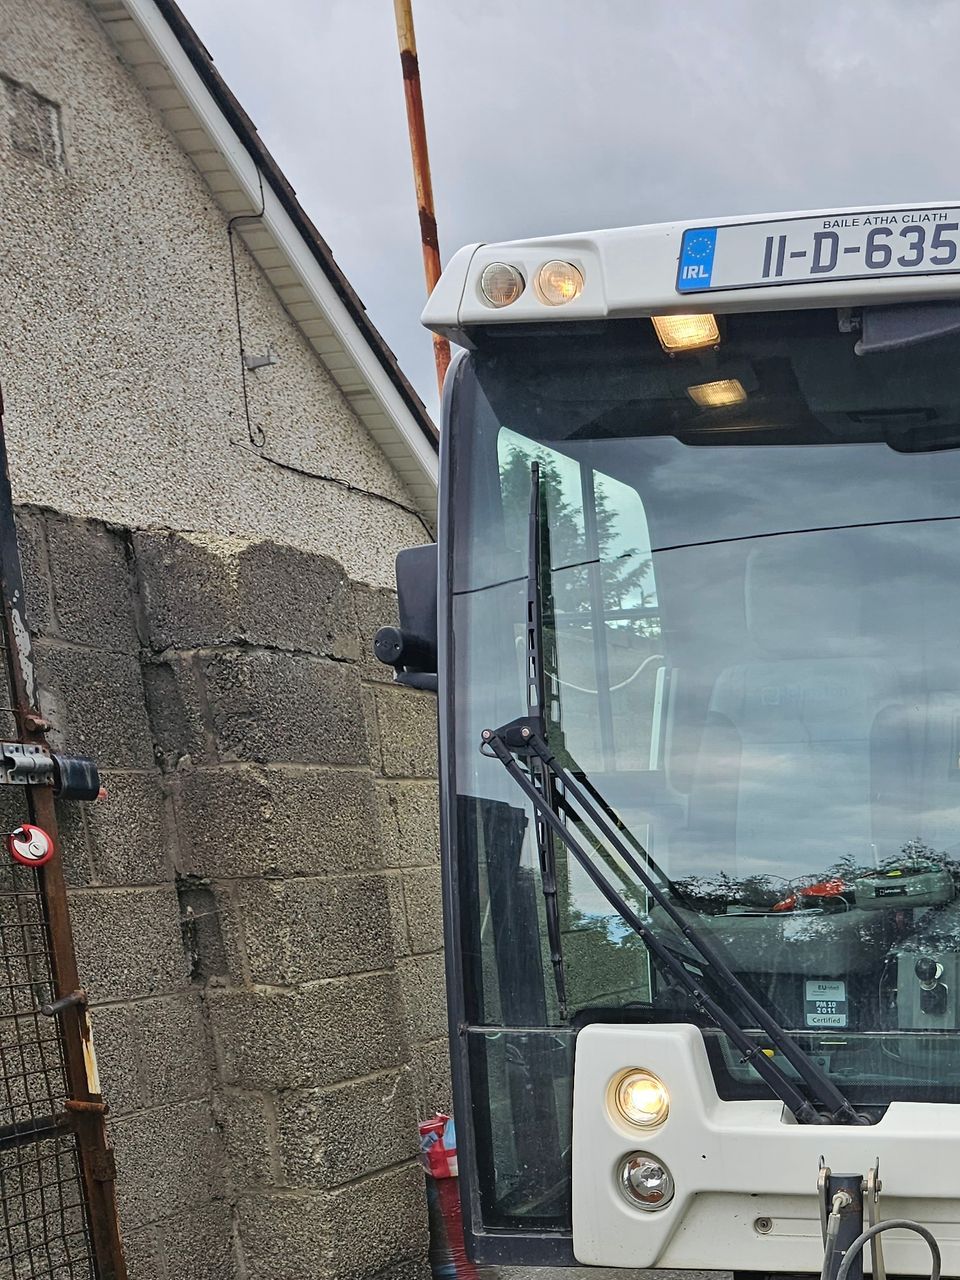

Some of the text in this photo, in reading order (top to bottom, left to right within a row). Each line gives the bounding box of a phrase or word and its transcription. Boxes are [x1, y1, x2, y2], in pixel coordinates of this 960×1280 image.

[822, 218, 860, 230] BAILE
[901, 212, 948, 225] CLIATH
[682, 265, 709, 280] IRL
